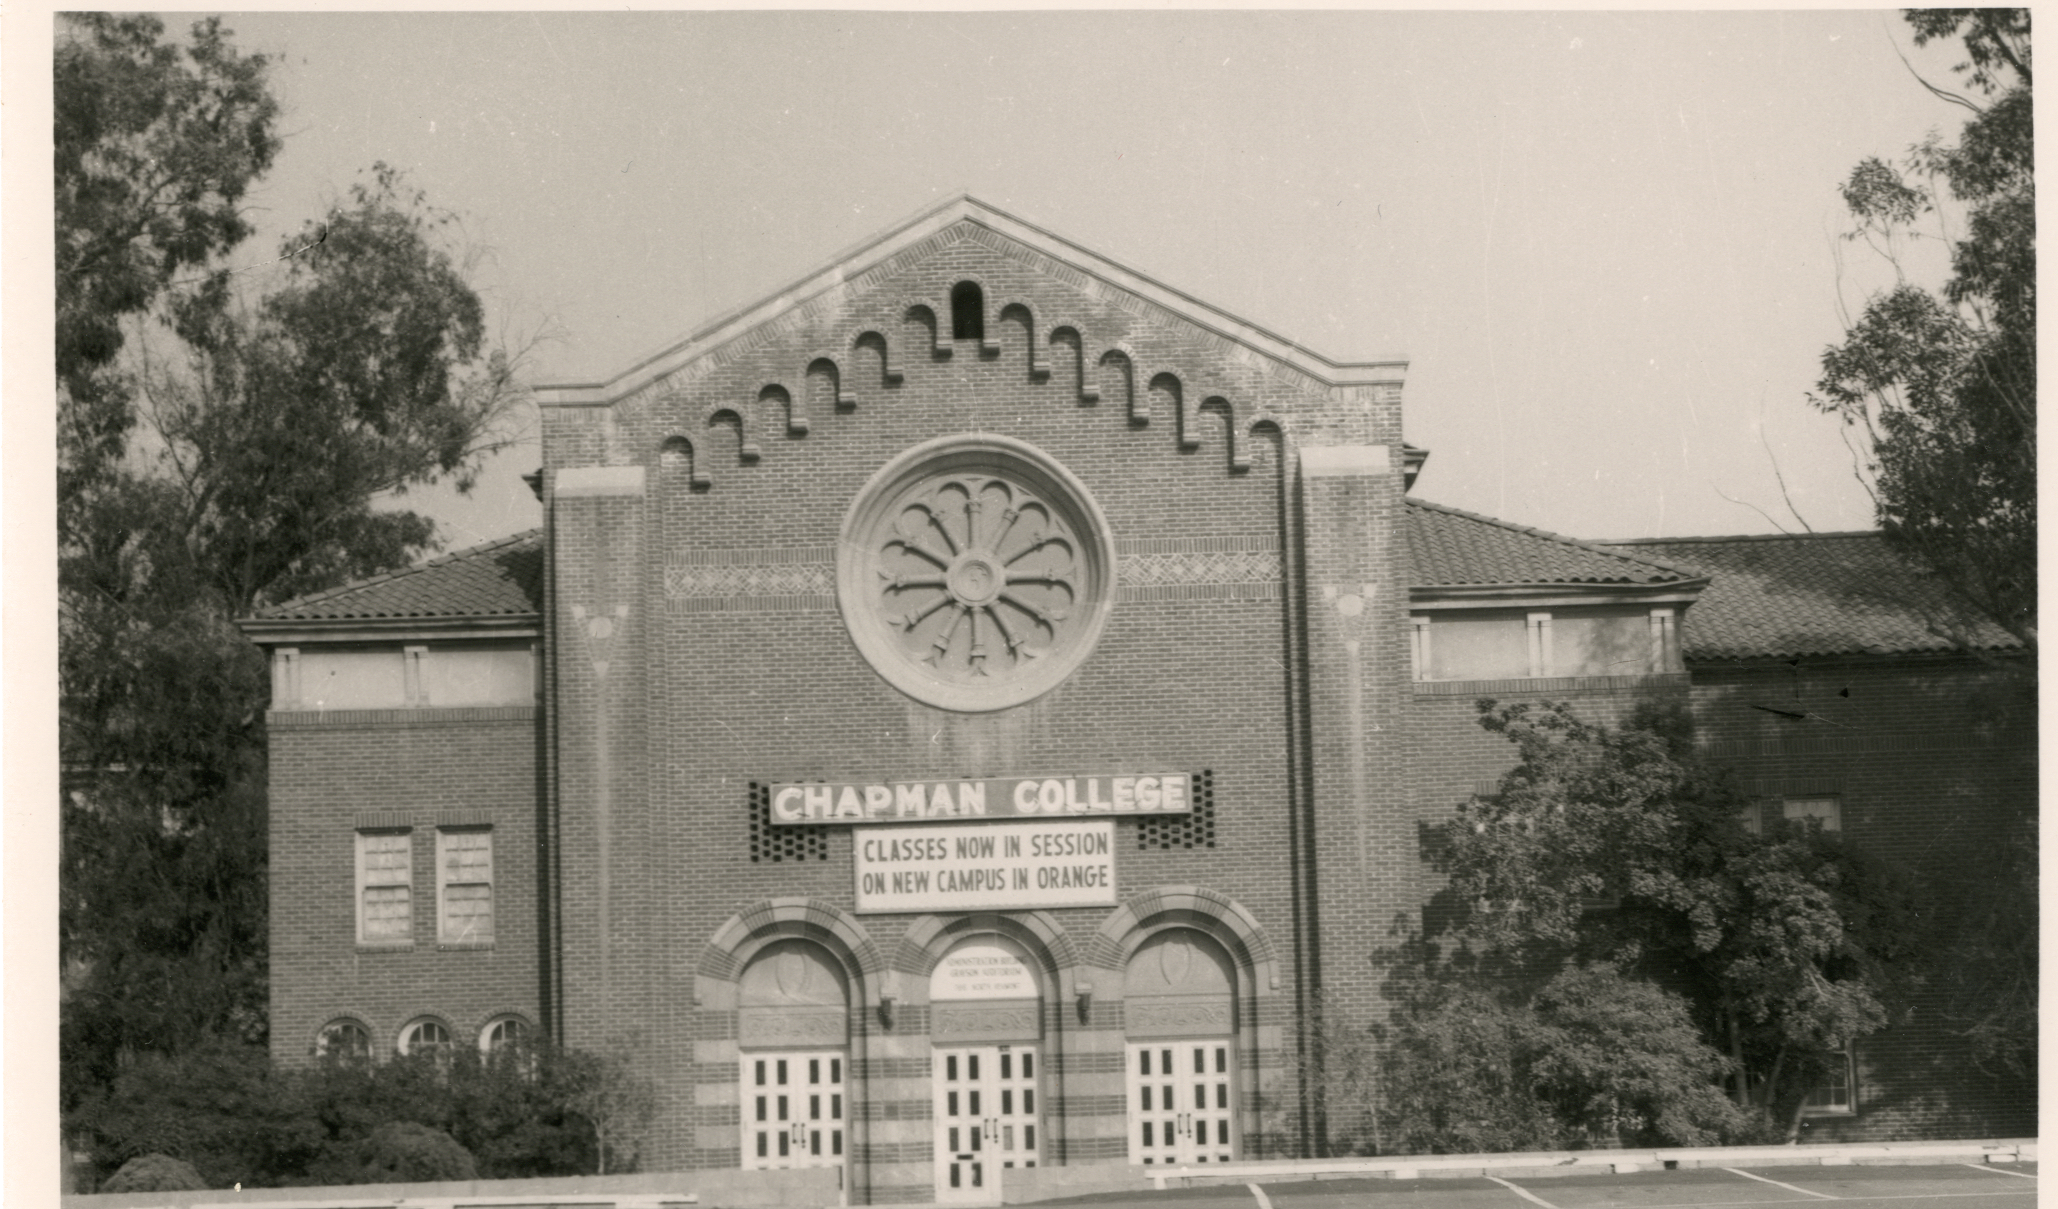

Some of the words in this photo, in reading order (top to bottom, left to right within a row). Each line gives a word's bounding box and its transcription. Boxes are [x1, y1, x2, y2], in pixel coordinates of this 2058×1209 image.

[774, 782, 986, 820] CHAPMAN
[1014, 776, 1187, 813] COLLEGE
[864, 838, 947, 862] CLASSES
[956, 836, 995, 859] NOW
[1005, 835, 1020, 858] IN
[1032, 832, 1108, 857] SESSION
[863, 872, 885, 895] ON
[893, 871, 930, 894] NEW
[937, 868, 1006, 892] CAMPUS
[1013, 867, 1028, 890] IN
[1037, 864, 1108, 889] ORANGE
